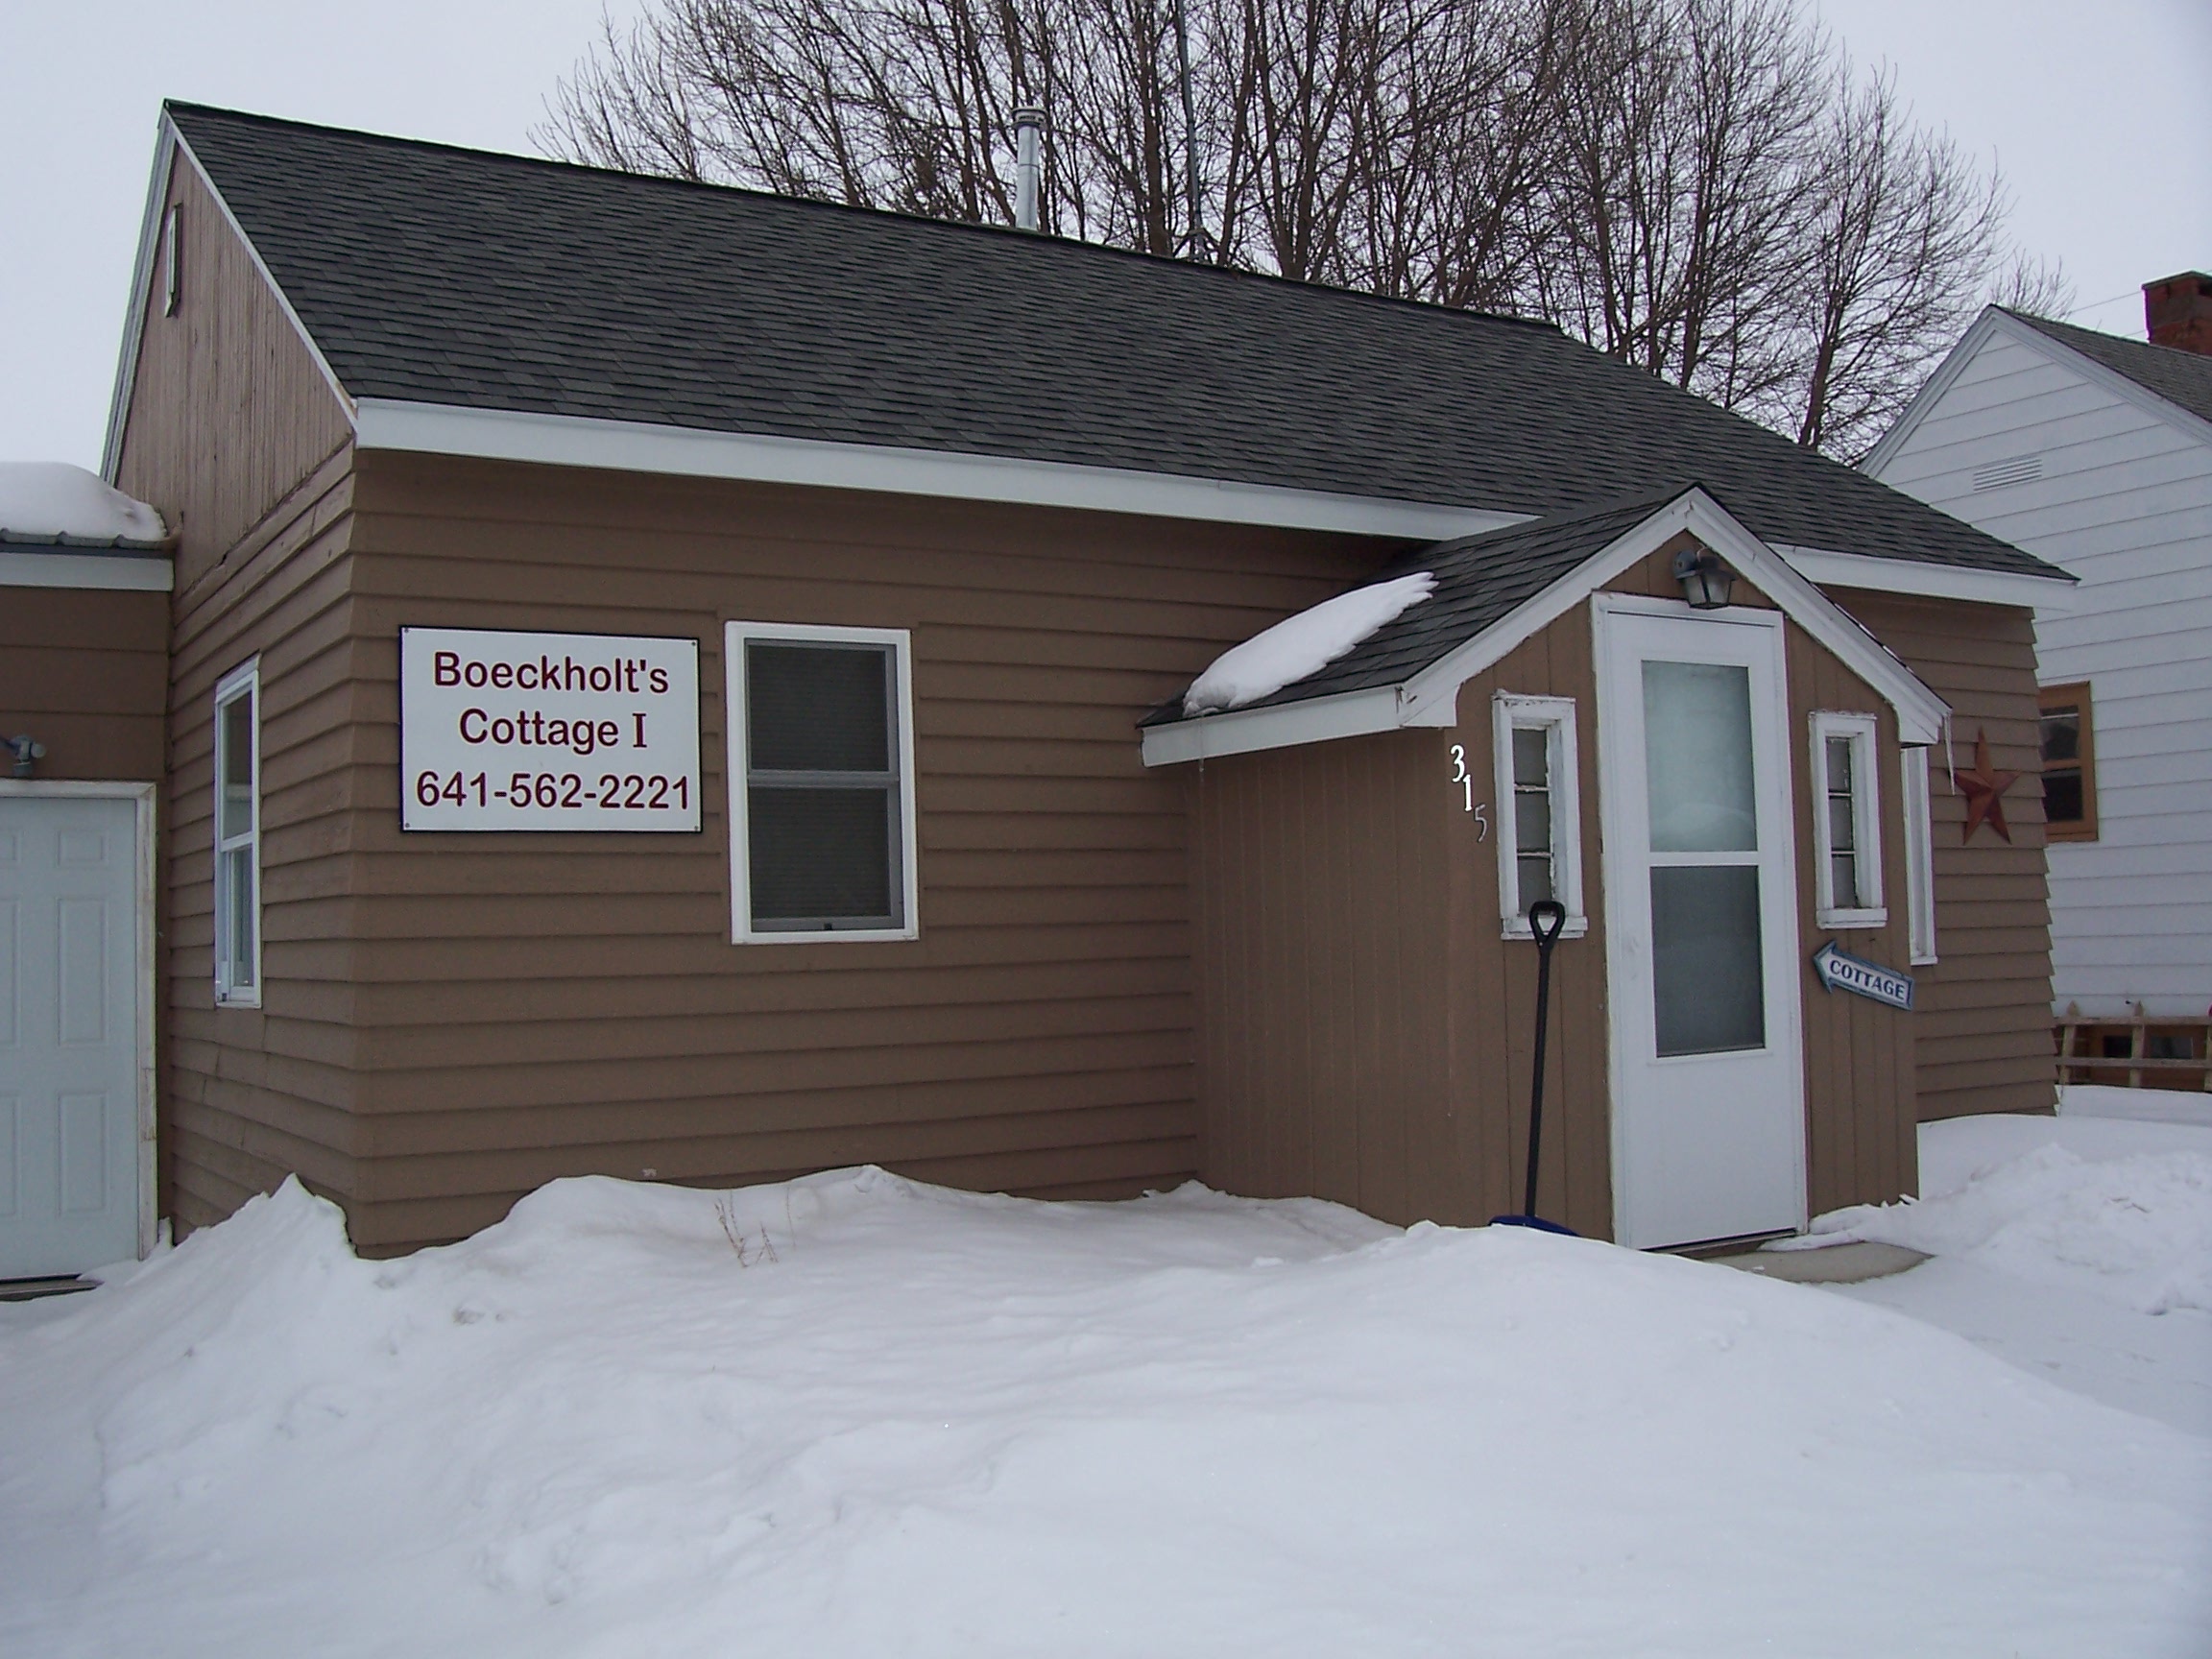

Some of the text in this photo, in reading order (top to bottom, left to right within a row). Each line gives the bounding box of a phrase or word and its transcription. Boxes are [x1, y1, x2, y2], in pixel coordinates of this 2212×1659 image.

[434, 651, 669, 694] Boeckholt's
[459, 708, 648, 756] Cottage I
[417, 771, 689, 810] 641-562-2221
[1450, 744, 1487, 842] 315
[1829, 960, 1905, 1000] COTTAGE
